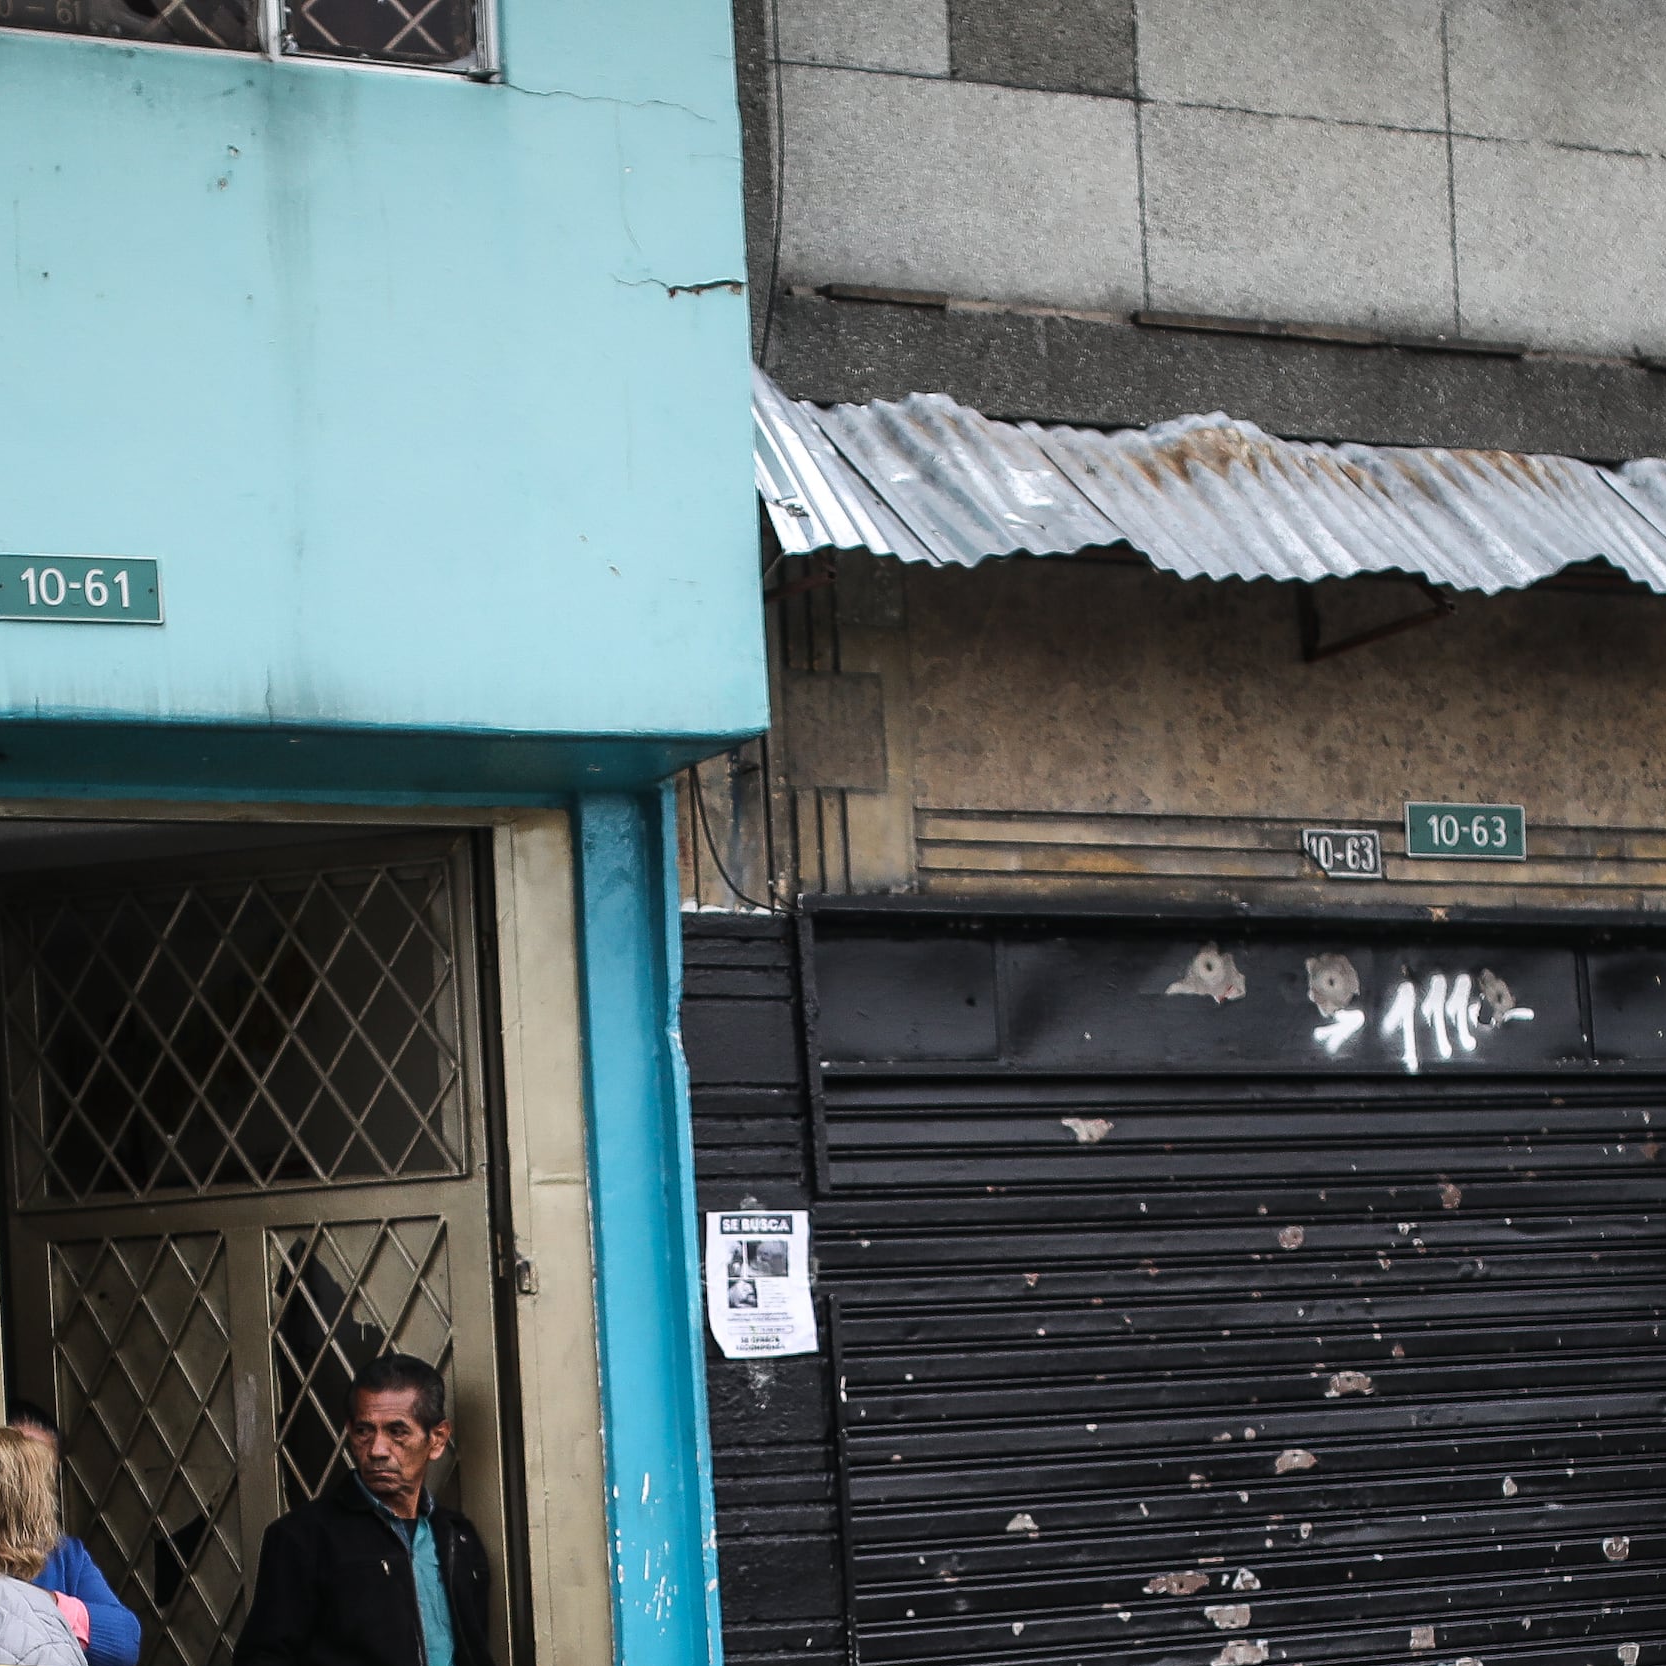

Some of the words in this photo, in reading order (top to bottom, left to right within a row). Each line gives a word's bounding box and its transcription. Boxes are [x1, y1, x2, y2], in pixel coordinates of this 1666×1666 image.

[20, 566, 130, 609] 10-61
[1426, 813, 1508, 848] 10-63
[1306, 834, 1377, 872] 10-63
[722, 1217, 740, 1232] SE
[741, 1217, 790, 1233] BUSCA
